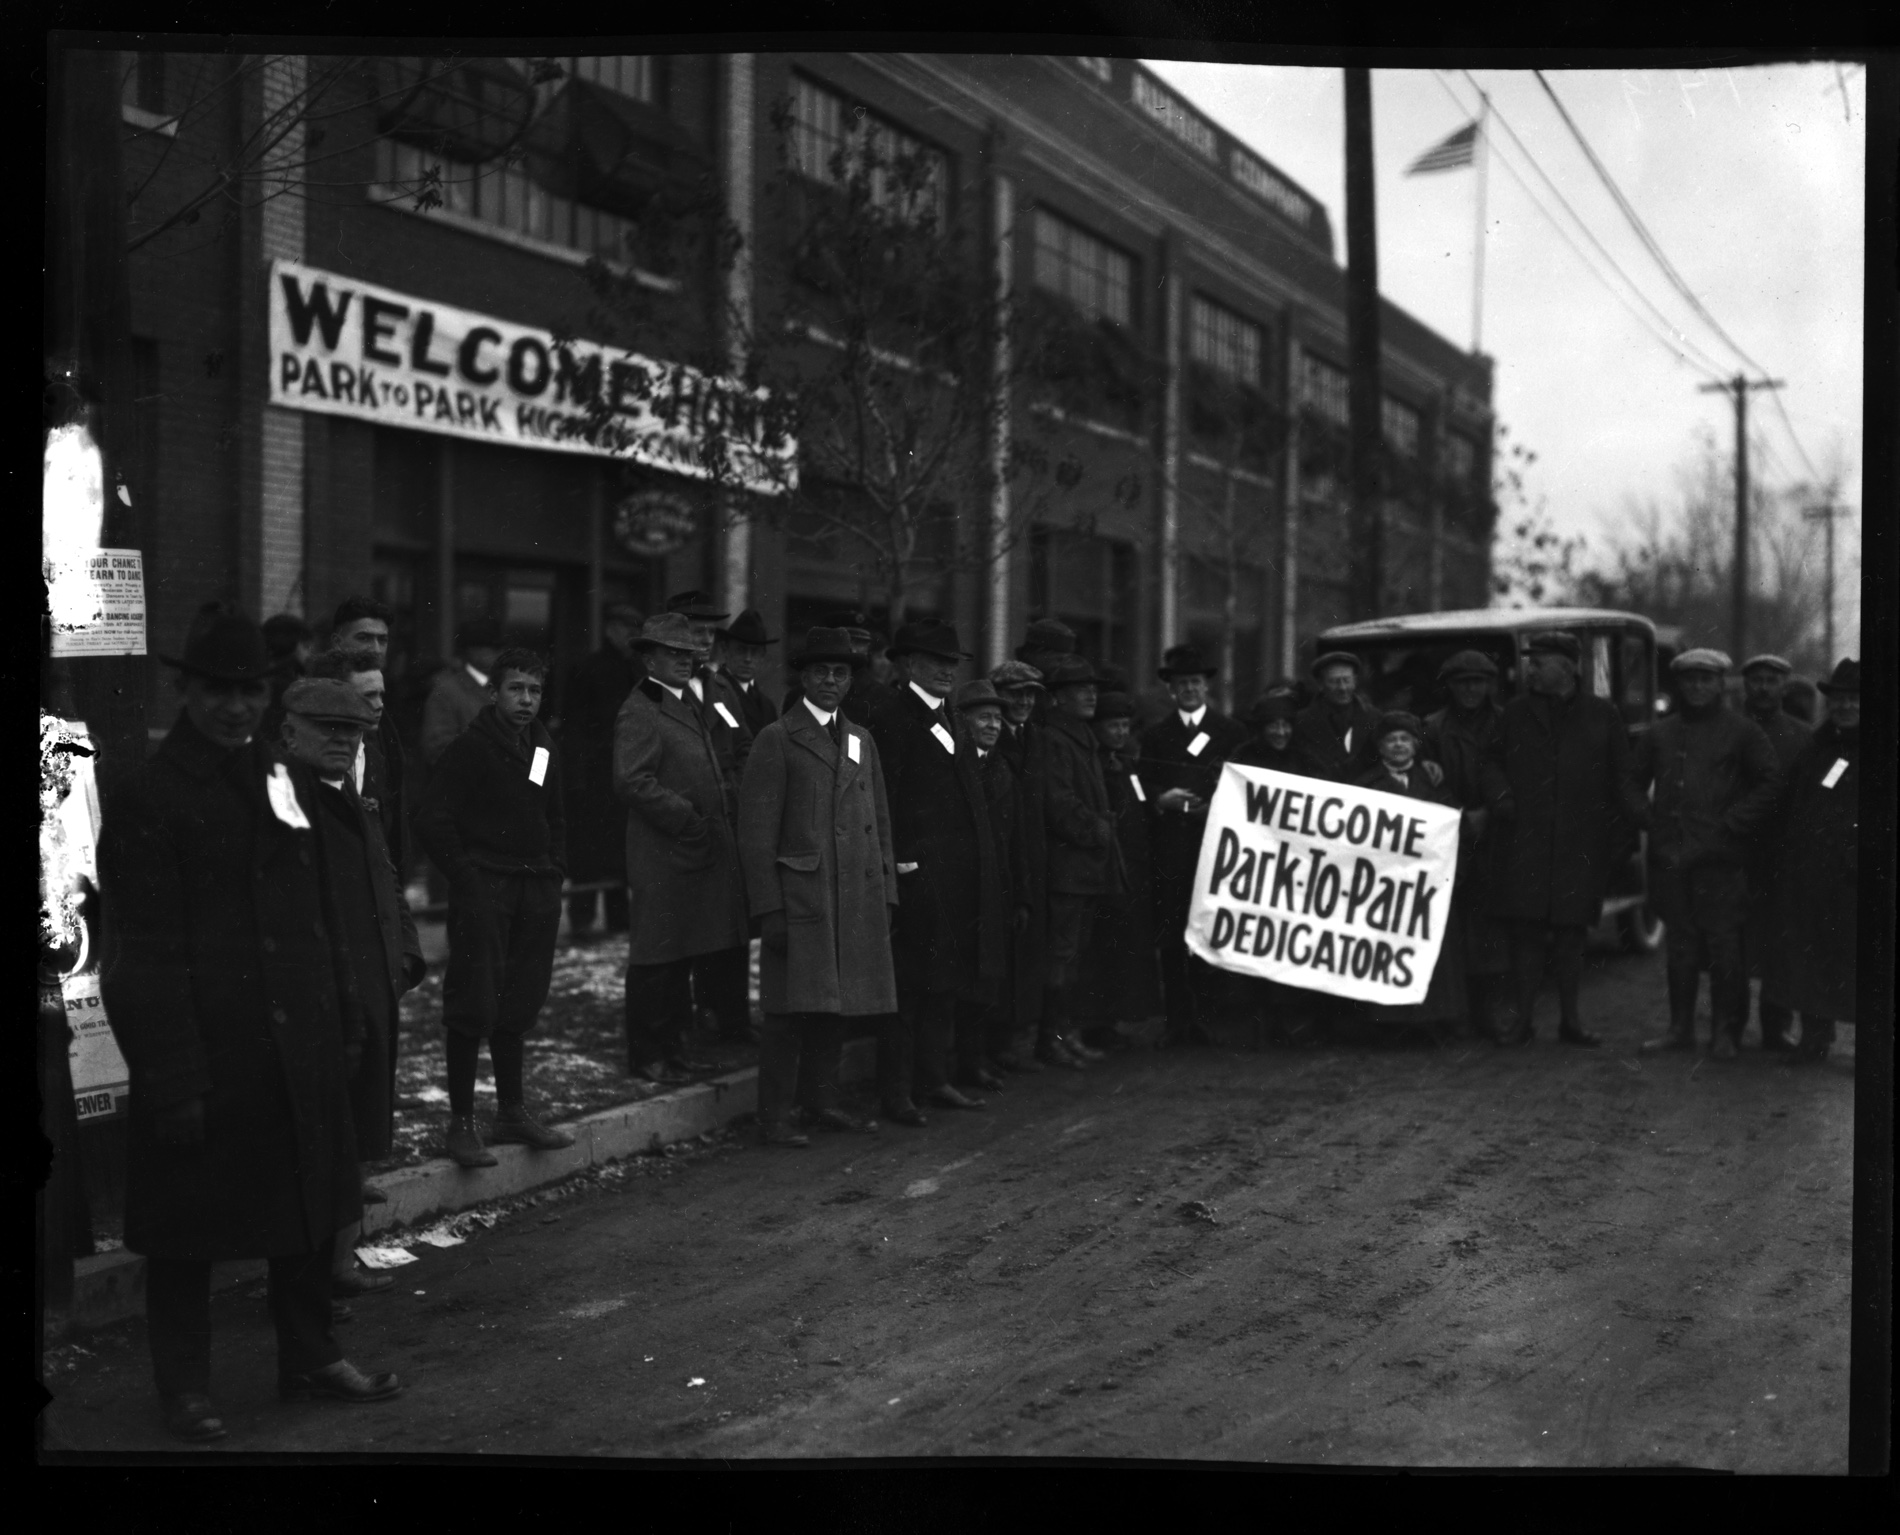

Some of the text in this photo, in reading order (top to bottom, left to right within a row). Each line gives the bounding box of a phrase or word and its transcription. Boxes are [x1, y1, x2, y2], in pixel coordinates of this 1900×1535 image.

[280, 273, 649, 418] WELCOME
[281, 352, 379, 410] PARK
[381, 381, 409, 408] TO
[414, 381, 502, 431] PARK
[112, 558, 137, 569] CHANCE
[117, 570, 126, 580] TO
[1246, 779, 1428, 859] WELCOME
[1210, 906, 1416, 988] DEDICATORS
[79, 1021, 97, 1031] GOOD
[76, 1092, 112, 1116] ENVER
